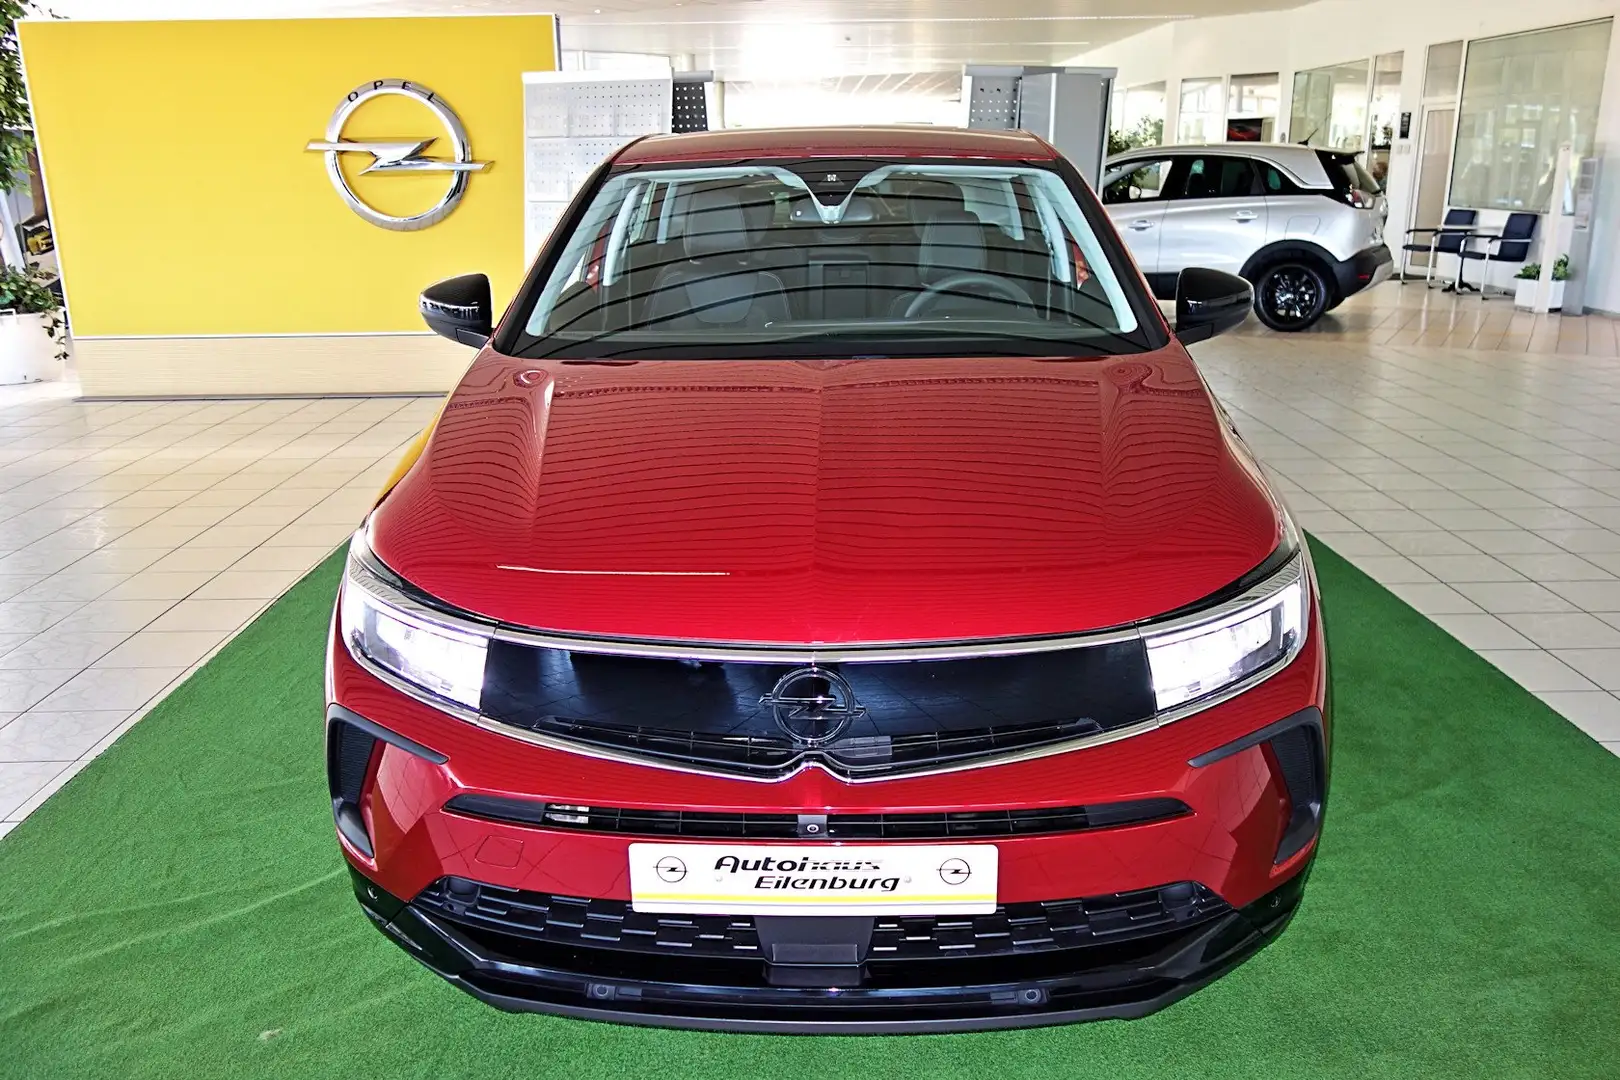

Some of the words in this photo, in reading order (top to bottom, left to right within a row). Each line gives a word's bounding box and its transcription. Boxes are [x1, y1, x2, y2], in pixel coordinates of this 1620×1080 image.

[347, 80, 435, 104] OPEL
[714, 855, 883, 873] Autohaus
[754, 876, 900, 892] Eilenburg
